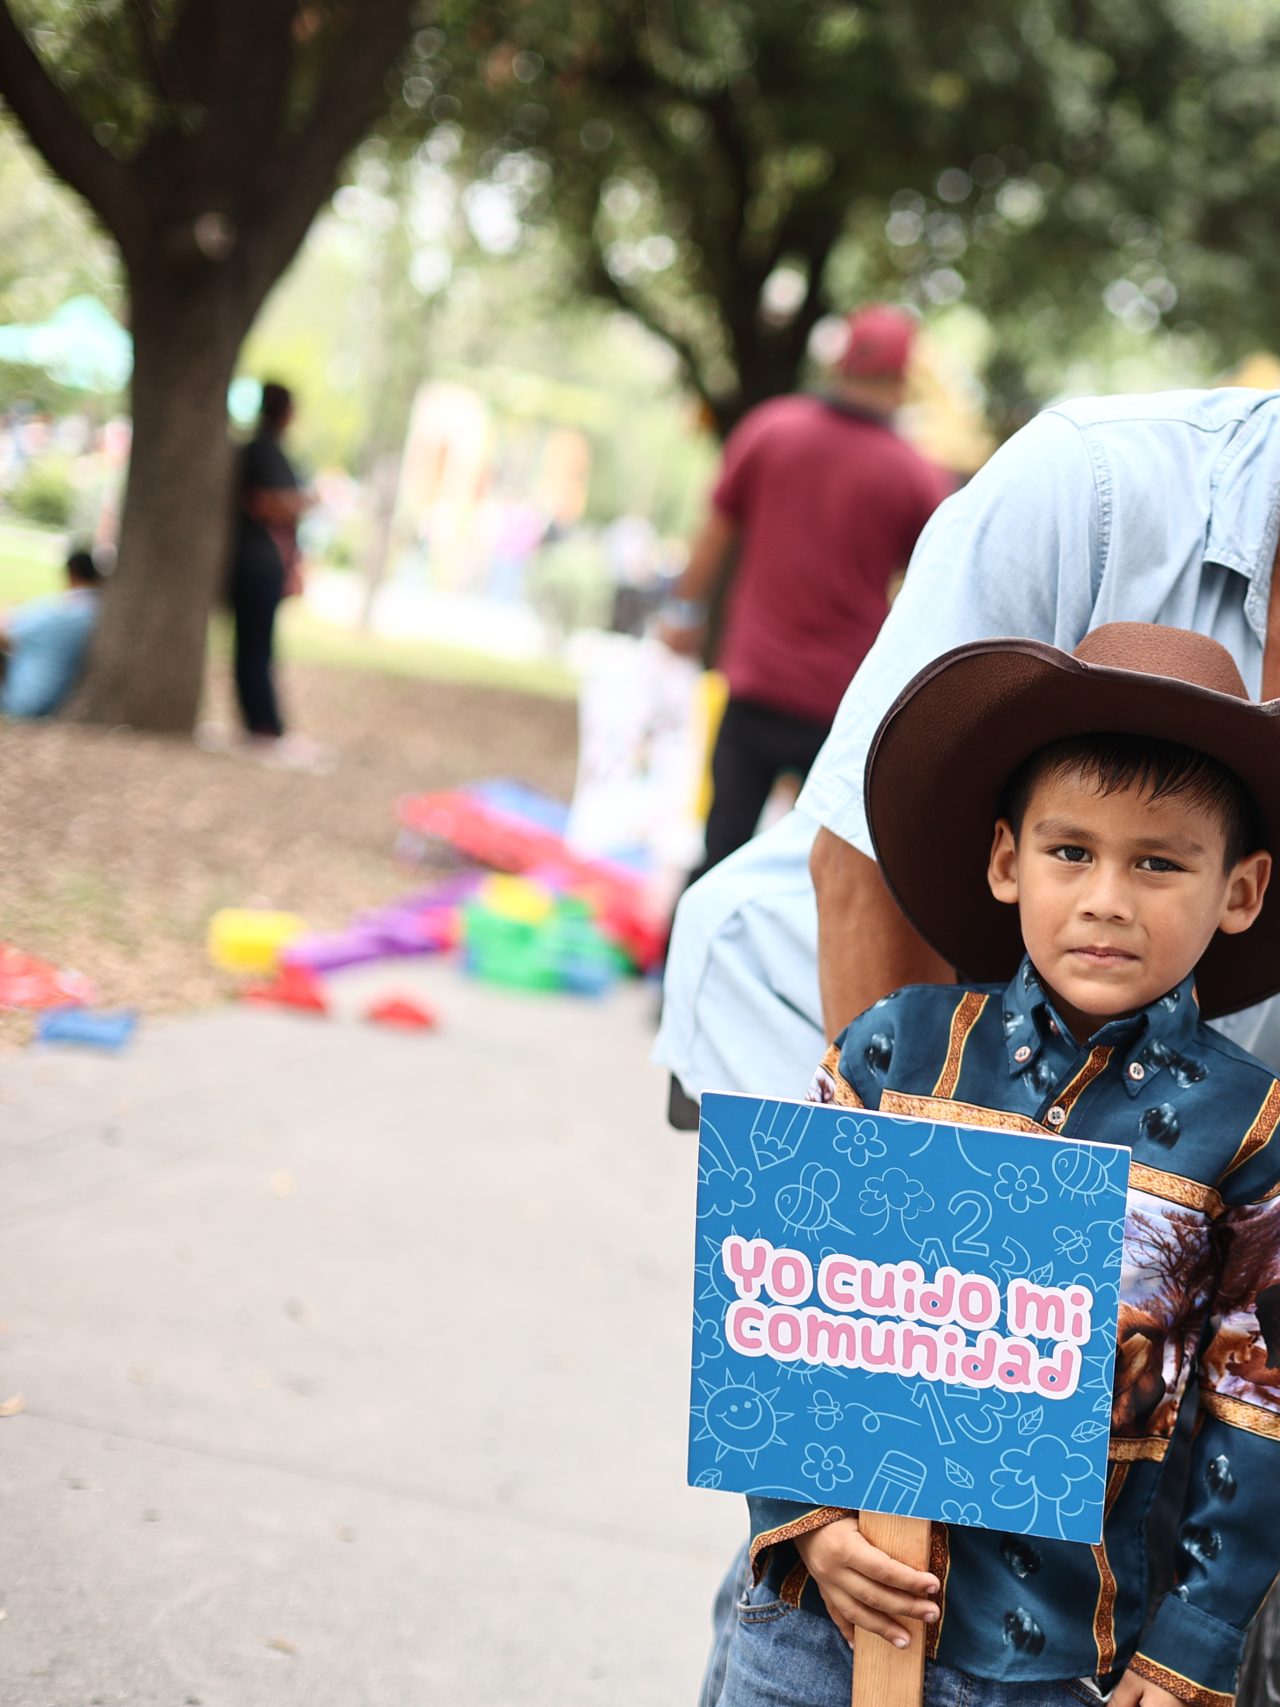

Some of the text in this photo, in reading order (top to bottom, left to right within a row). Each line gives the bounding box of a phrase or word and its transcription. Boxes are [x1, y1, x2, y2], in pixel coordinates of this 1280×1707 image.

[729, 1242, 806, 1298] Yo
[1014, 1285, 1086, 1338] mi
[732, 1306, 1075, 1394] comunidad
